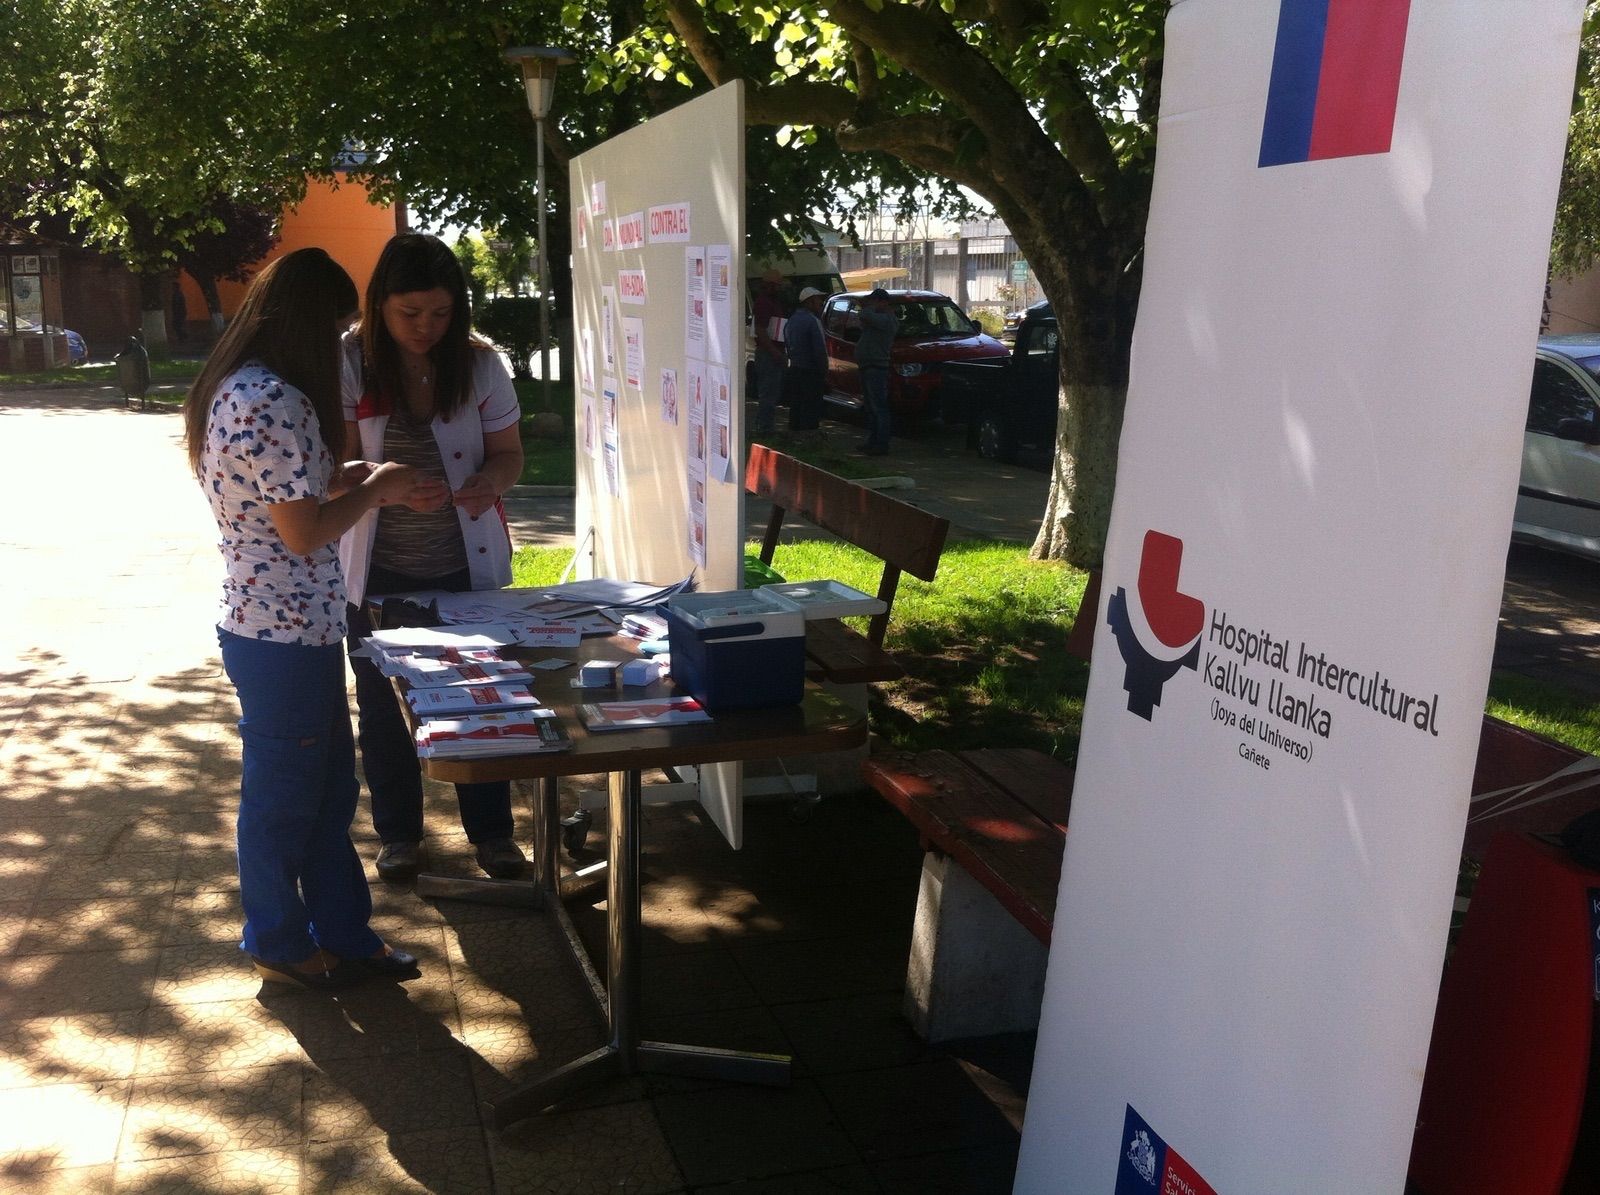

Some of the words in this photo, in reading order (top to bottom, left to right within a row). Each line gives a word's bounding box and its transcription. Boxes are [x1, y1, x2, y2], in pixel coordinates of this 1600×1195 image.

[651, 210, 677, 235] CONTRA
[679, 209, 688, 233] EL
[1203, 652, 1262, 707] Kallvu
[1209, 609, 1289, 674] Hospital
[1296, 642, 1439, 737] Intercultural
[1210, 697, 1237, 727] (Joya
[1239, 713, 1255, 735] del
[1258, 723, 1314, 763] Universo)
[1238, 742, 1271, 770] Cañete
[1167, 1166, 1196, 1195] Servici
